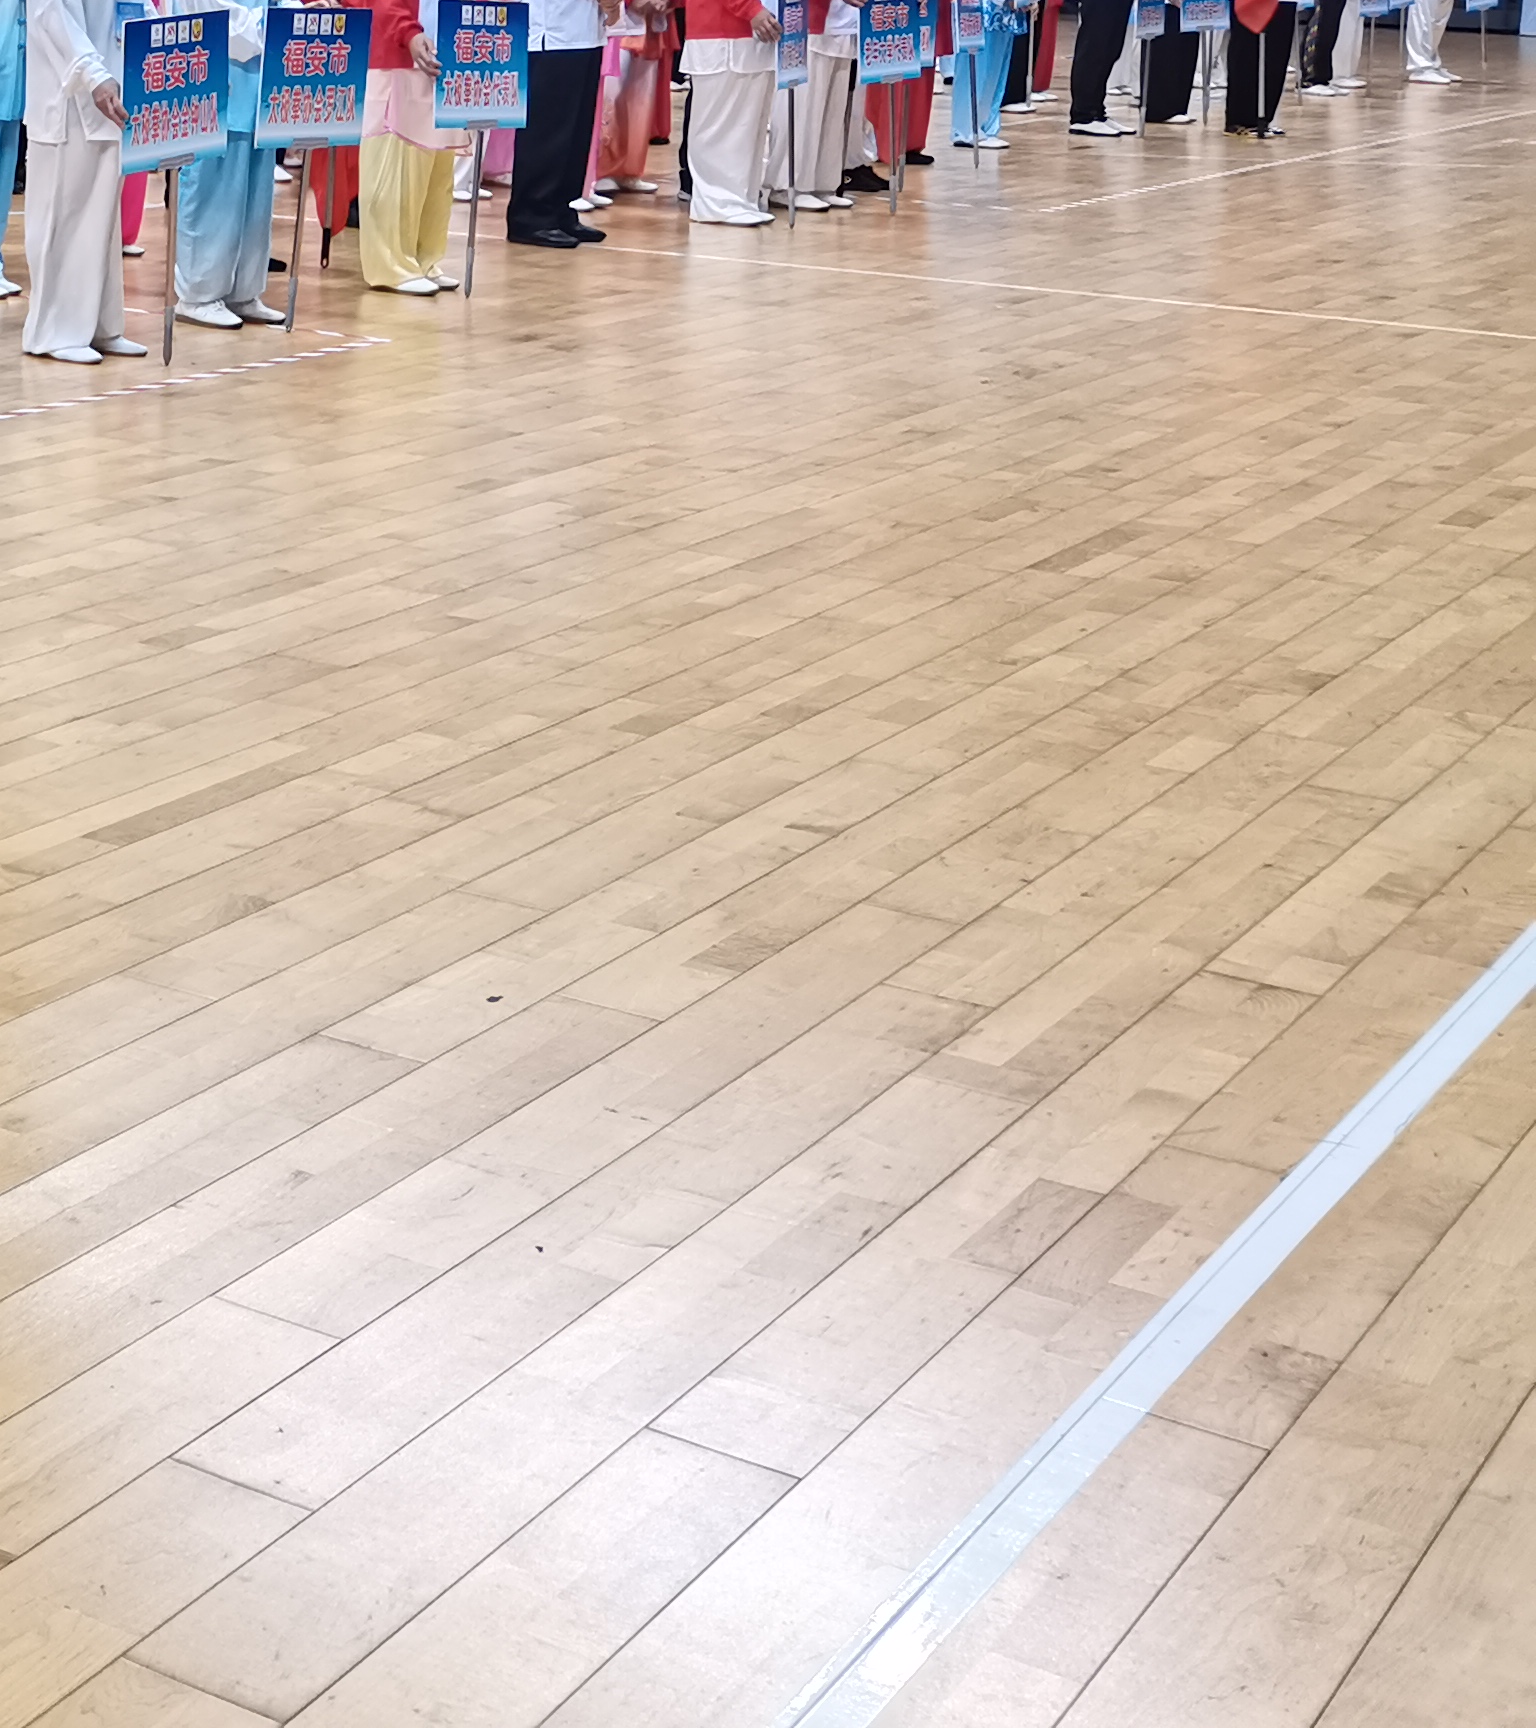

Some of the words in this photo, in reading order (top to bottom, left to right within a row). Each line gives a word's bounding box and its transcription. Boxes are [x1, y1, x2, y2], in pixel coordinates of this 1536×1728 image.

[870, 2, 911, 32] 福安市
[282, 38, 352, 77] 福安市
[454, 28, 514, 64] 福安市
[142, 45, 210, 94] 福安市
